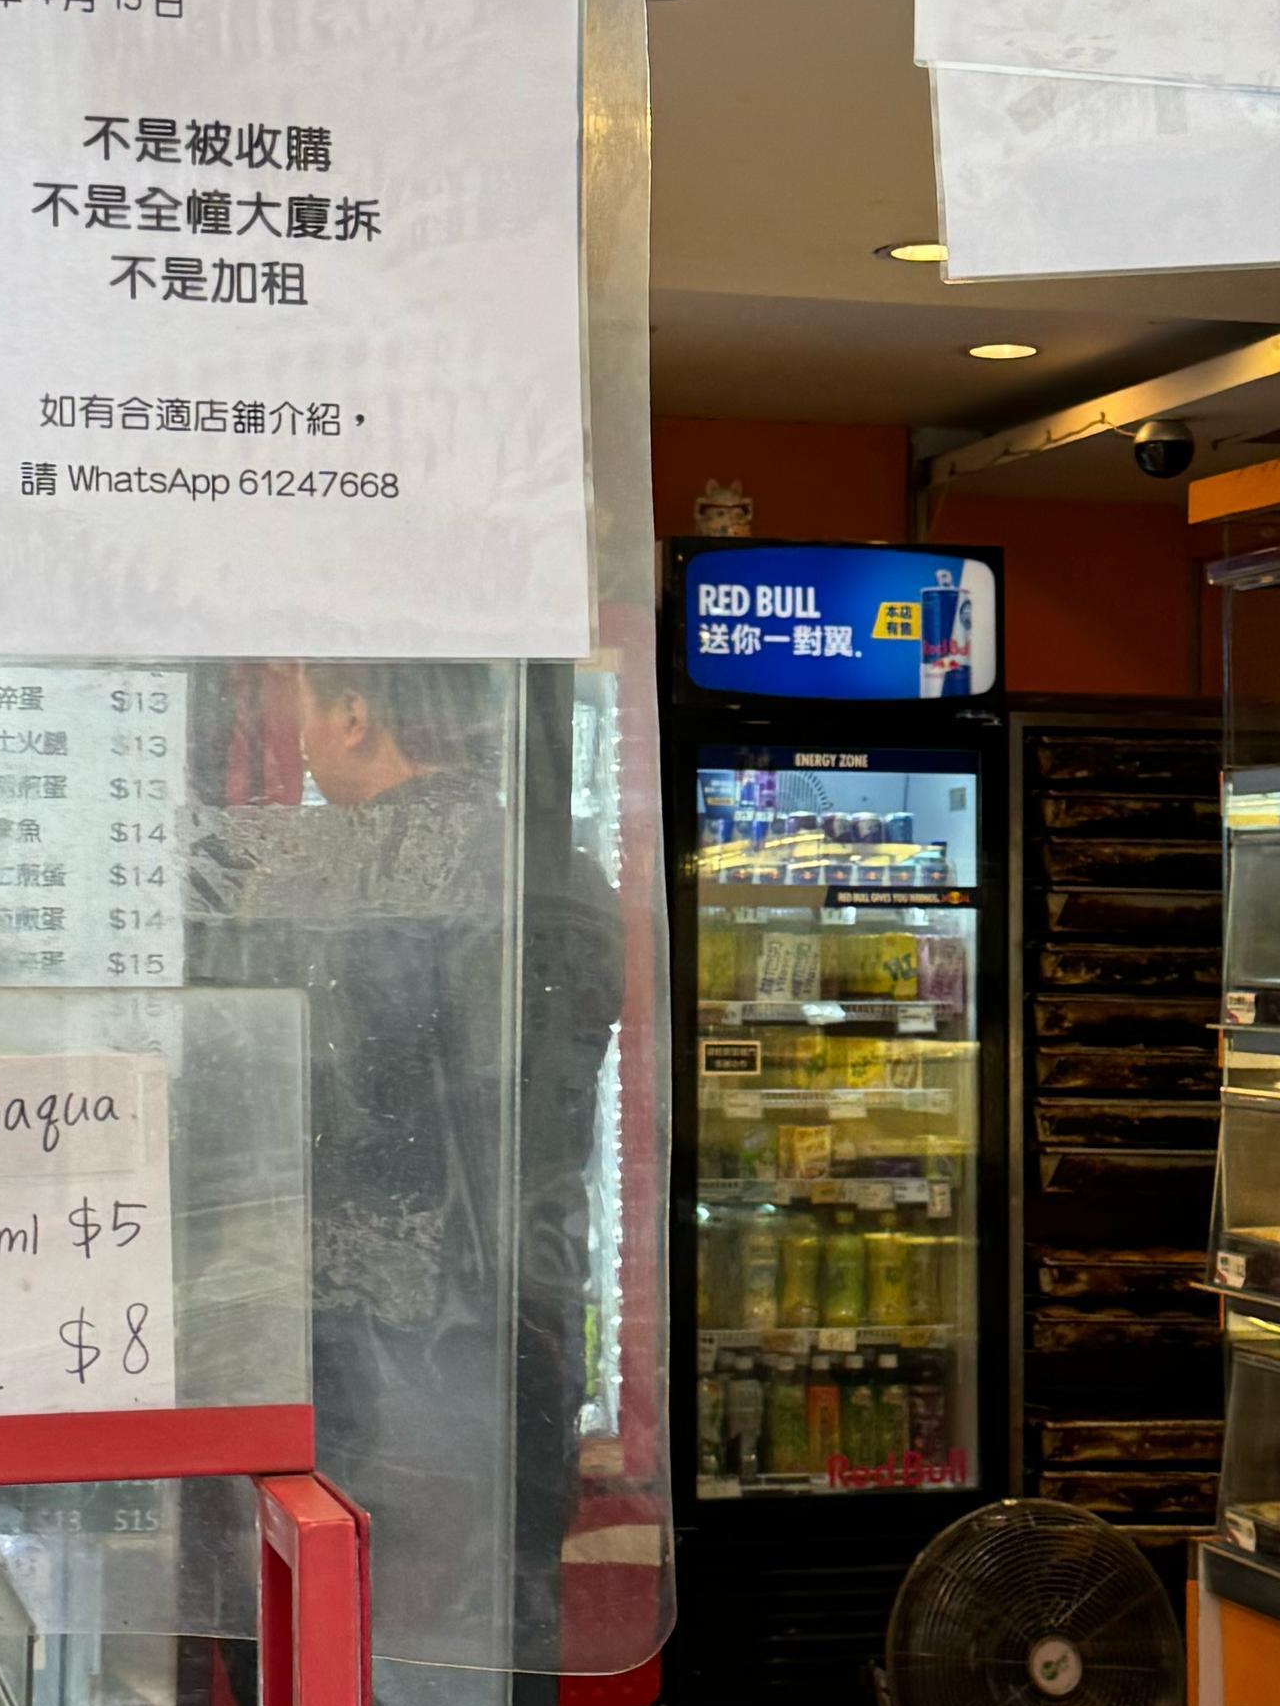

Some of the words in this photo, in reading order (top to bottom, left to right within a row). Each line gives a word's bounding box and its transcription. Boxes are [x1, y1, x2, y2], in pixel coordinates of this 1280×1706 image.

[82, 115, 332, 172] 不是被收購
[31, 181, 383, 243] 不是全幢大廈拆
[109, 255, 309, 306] 不是加租
[20, 461, 57, 497] 請
[67, 464, 230, 502] WhatsApp
[238, 468, 400, 500] 61247668
[700, 584, 750, 617] RED
[755, 586, 822, 619] BULL
[794, 753, 837, 768] ENERGY
[839, 754, 869, 769] ZONE
[109, 822, 167, 844] $14
[109, 864, 166, 887] $14
[108, 952, 166, 976] $15
[69, 1196, 148, 1250] $5
[58, 1301, 151, 1384] $8
[827, 1451, 895, 1488] Red
[902, 1449, 967, 1484] Bull
